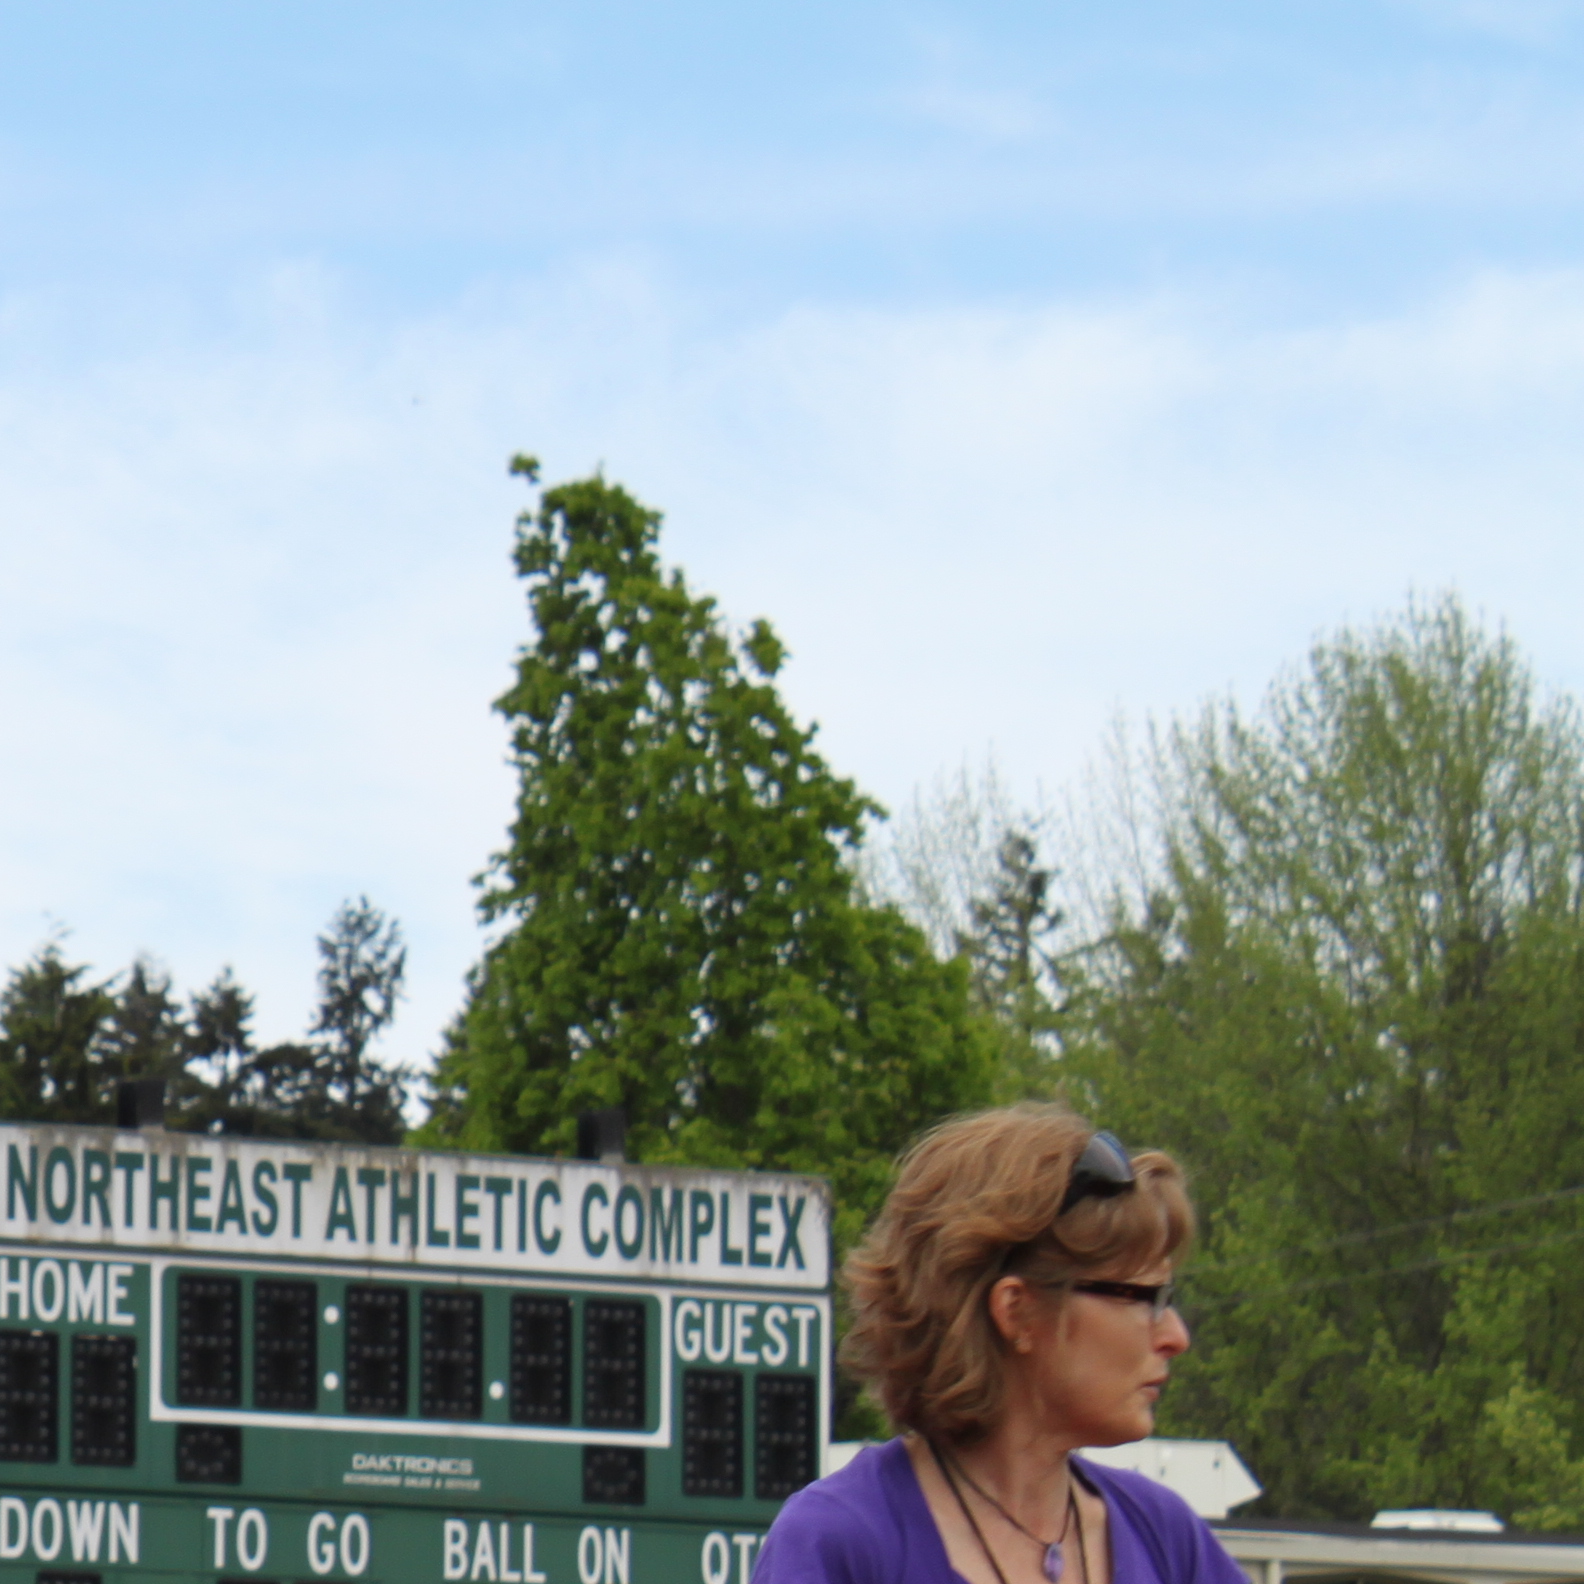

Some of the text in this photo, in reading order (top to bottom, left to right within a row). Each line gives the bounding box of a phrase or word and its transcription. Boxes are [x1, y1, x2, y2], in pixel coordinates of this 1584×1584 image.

[7, 1142, 807, 1271] NORTHEAST ATHLETIC COMPLEX
[673, 1299, 818, 1368] GUEST
[352, 1453, 474, 1475] DAKTRONICS
[206, 1506, 370, 1576] TO GO
[443, 1518, 547, 1584] BALL
